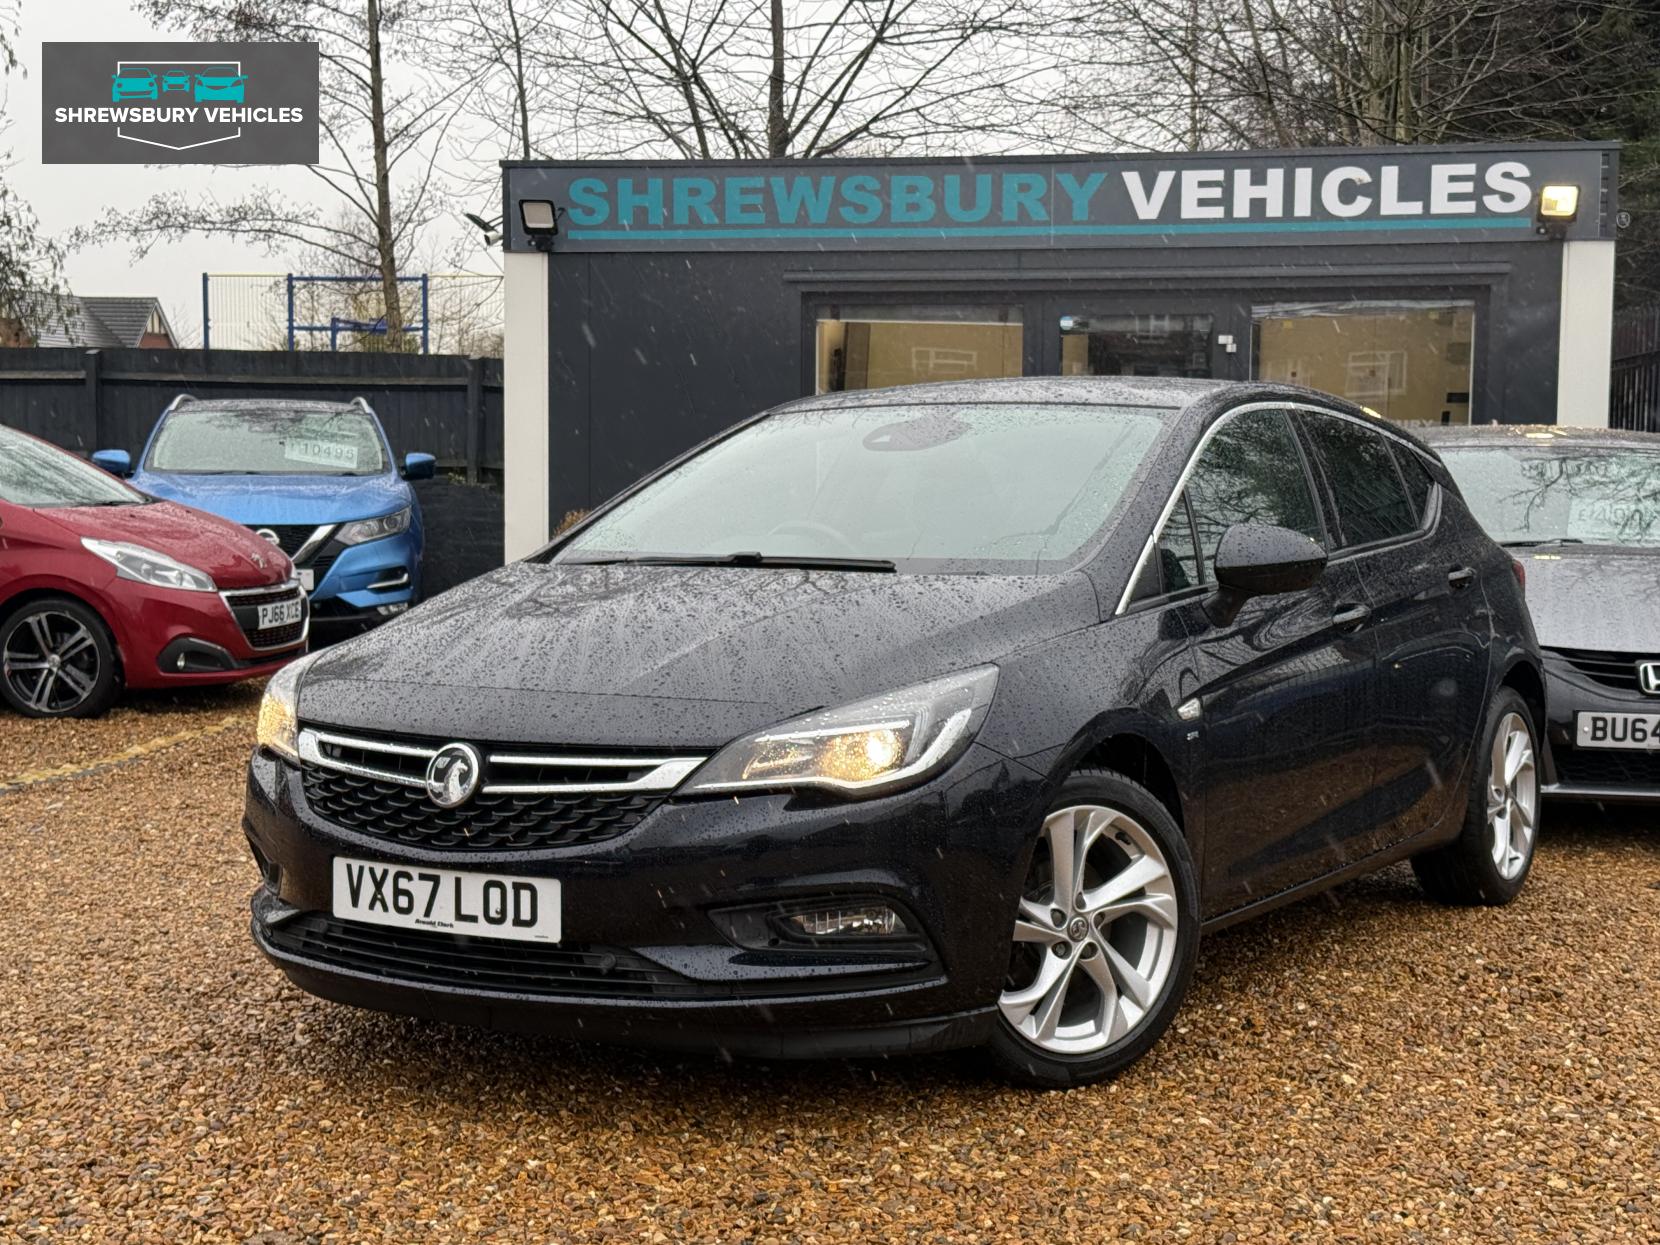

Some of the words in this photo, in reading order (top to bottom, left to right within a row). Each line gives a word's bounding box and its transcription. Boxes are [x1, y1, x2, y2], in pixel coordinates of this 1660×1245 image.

[568, 172, 1108, 226] SHREWSBURY
[1121, 161, 1532, 220] VEHICLES
[261, 604, 285, 626] PJ66
[346, 863, 441, 918] VX67
[454, 876, 539, 929] LOD
